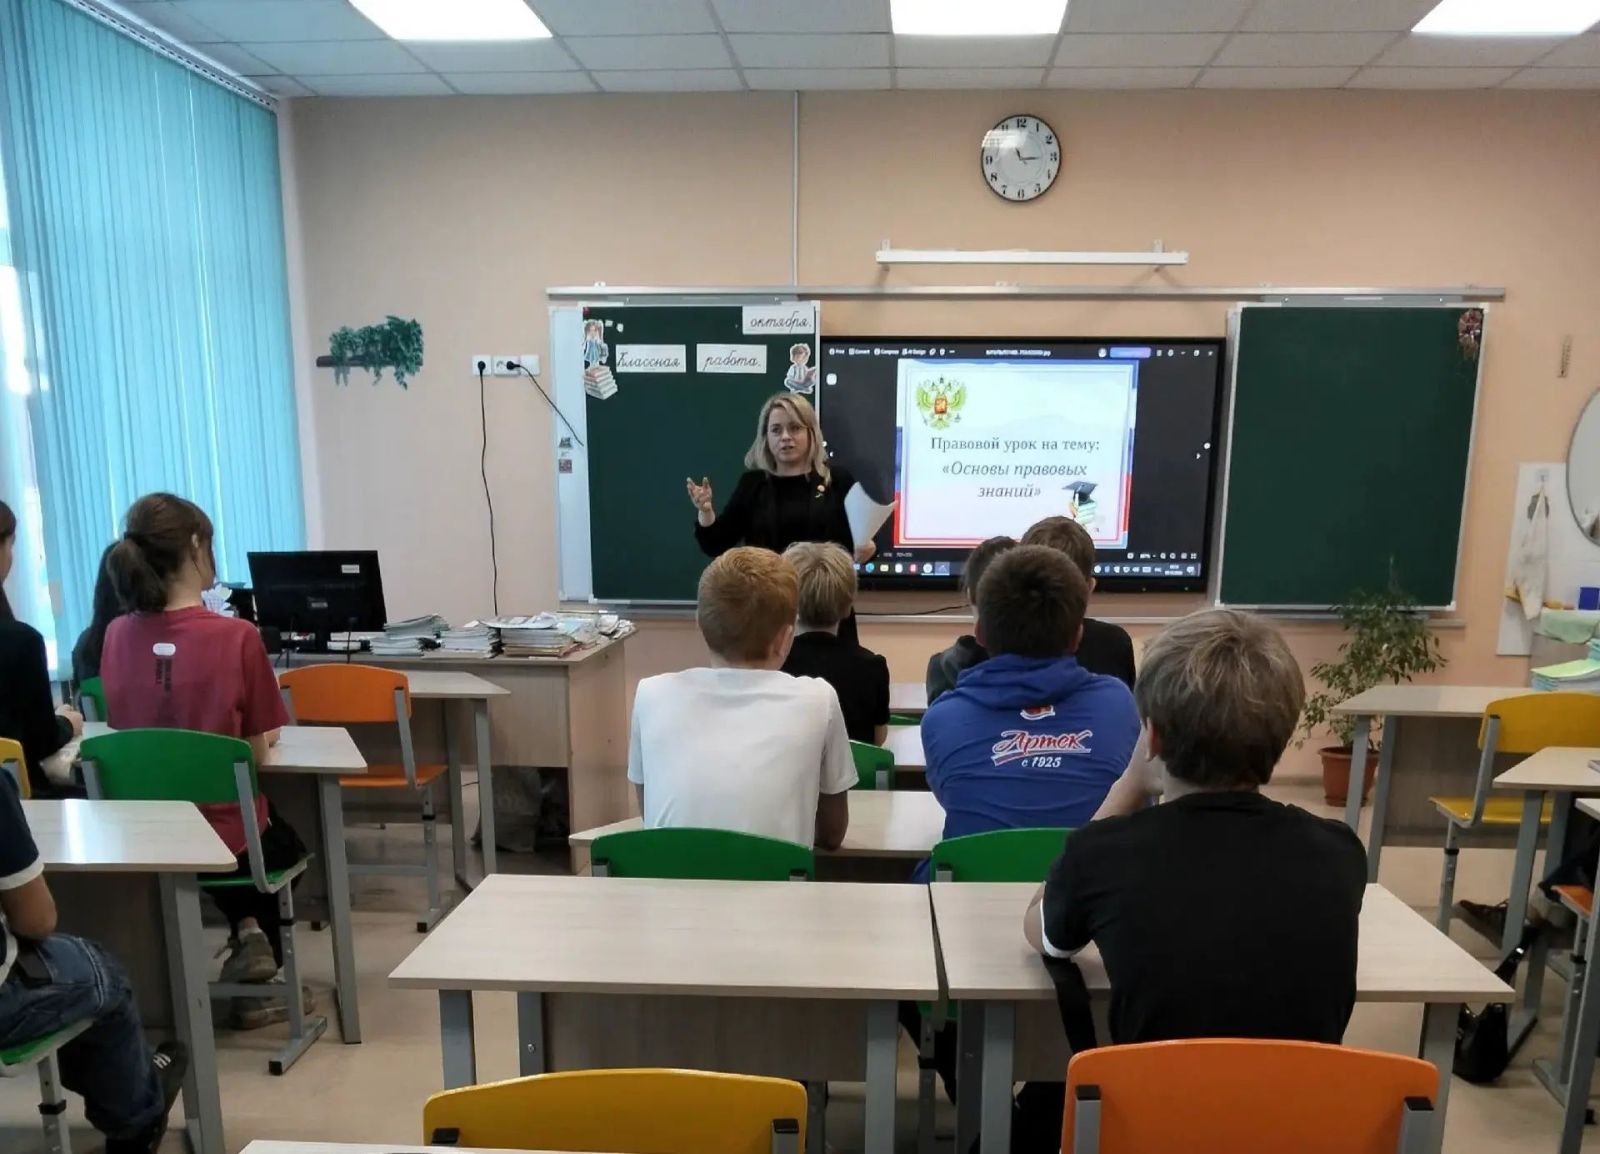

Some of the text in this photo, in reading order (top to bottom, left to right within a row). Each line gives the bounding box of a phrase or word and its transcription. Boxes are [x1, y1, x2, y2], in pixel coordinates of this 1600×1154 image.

[1017, 118, 1027, 128] 12
[1045, 135, 1053, 144] 2
[750, 311, 812, 333] октября.
[616, 350, 762, 370] Классная работа.
[931, 437, 1100, 453] Правовой урок на тему:
[942, 461, 1088, 479] «Основы правовых
[977, 484, 1041, 499] знаний»
[992, 729, 1093, 755] Артек
[1031, 756, 1062, 768] 1925
